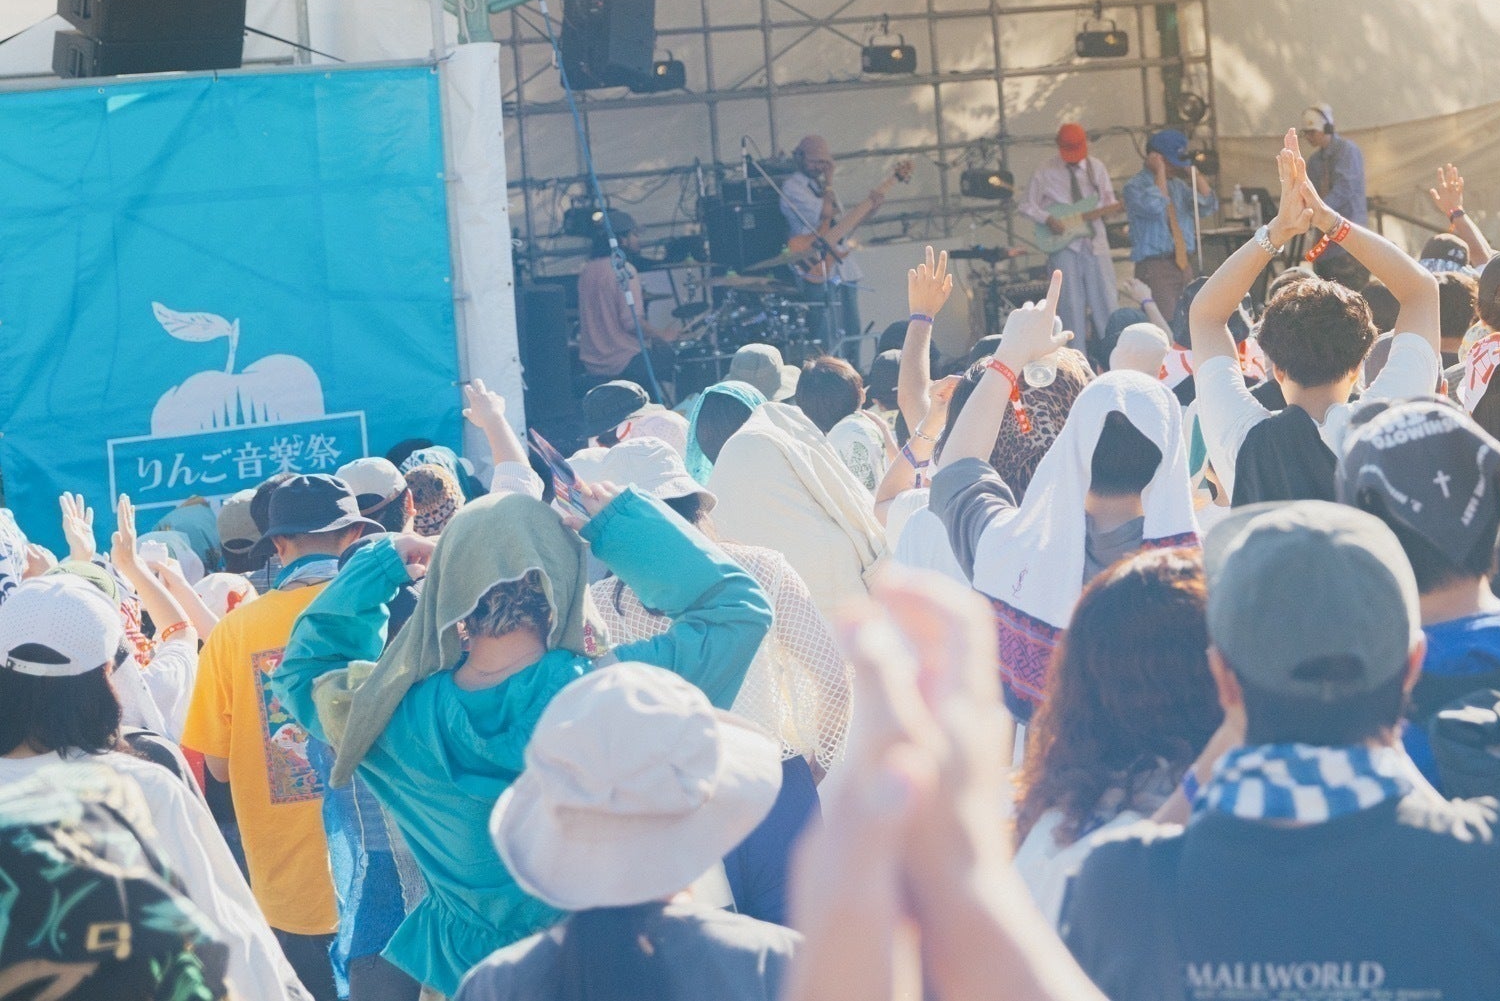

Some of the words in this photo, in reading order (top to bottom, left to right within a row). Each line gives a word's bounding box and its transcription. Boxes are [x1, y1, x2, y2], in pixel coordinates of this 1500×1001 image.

[137, 433, 342, 492] りんご音楽祭
[1186, 960, 1386, 990] MALLWORLD
